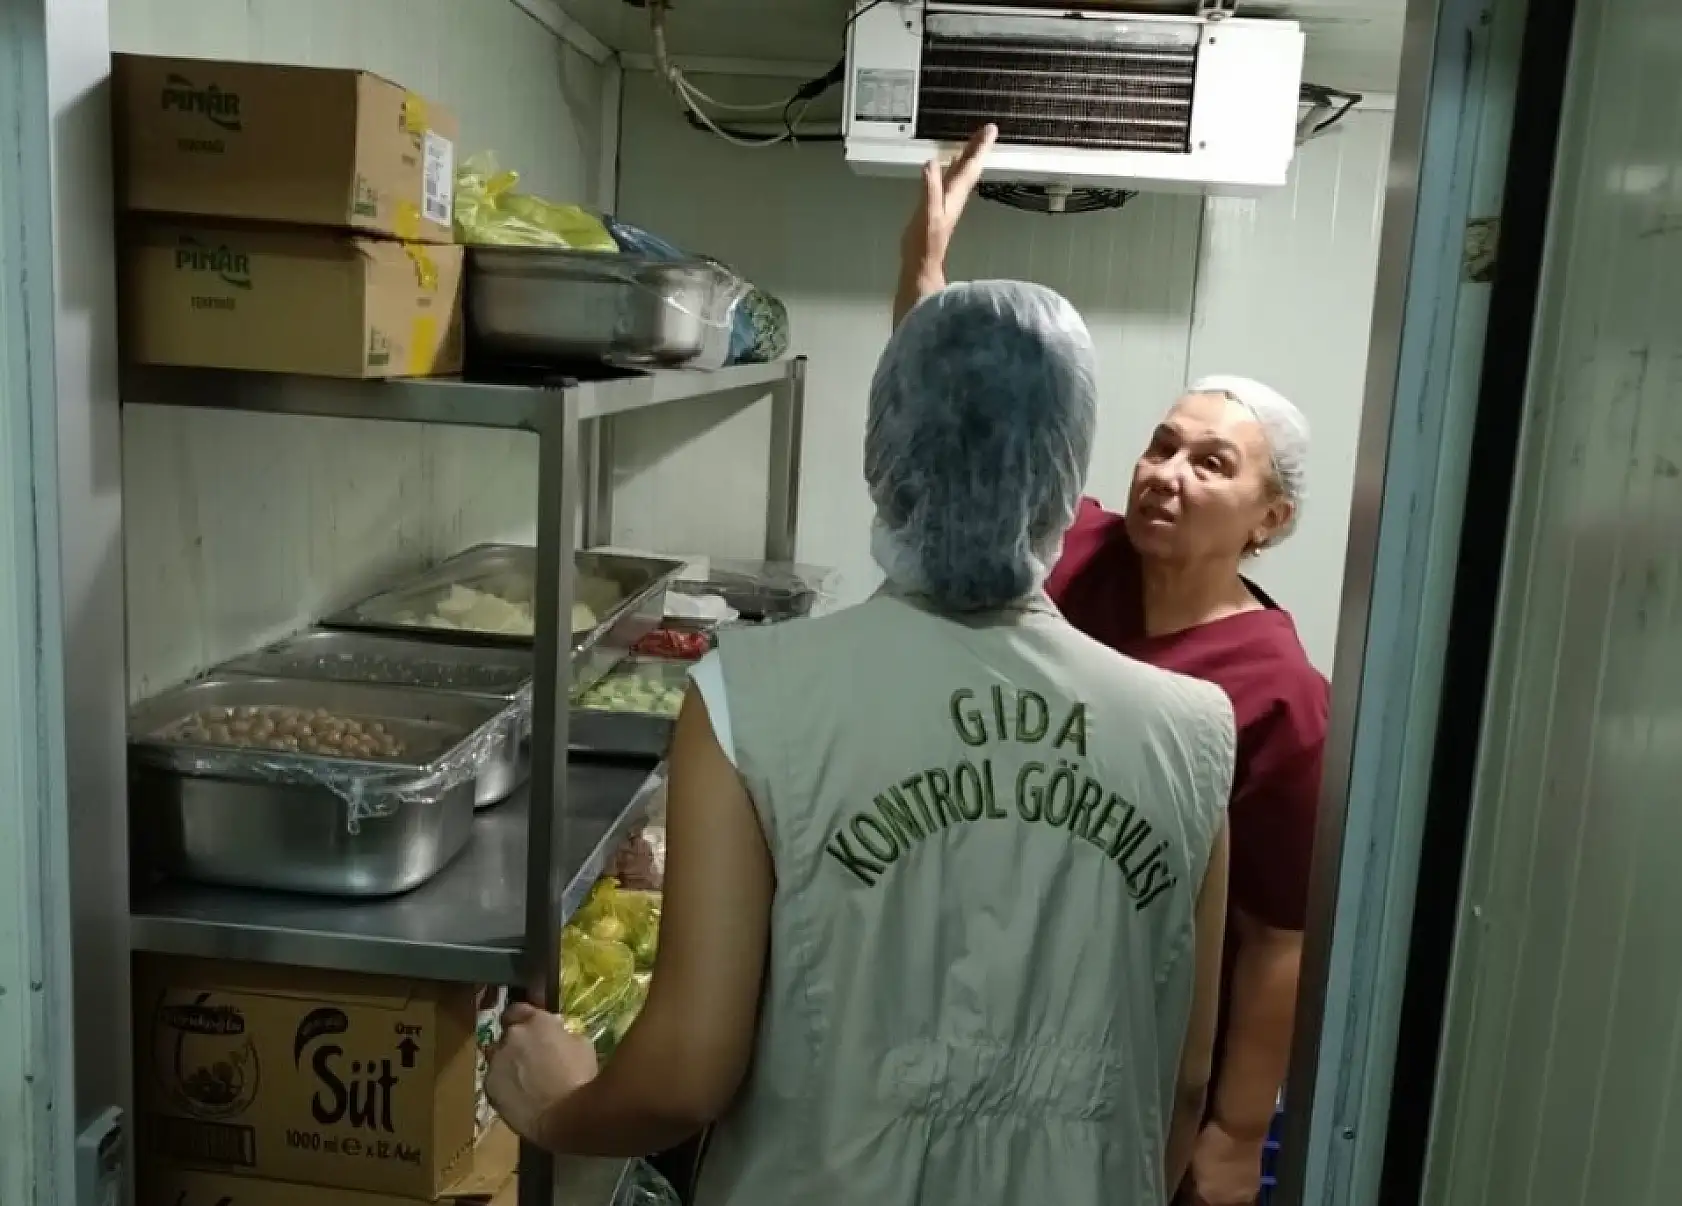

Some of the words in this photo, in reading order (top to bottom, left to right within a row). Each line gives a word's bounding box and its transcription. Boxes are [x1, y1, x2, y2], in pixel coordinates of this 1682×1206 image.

[949, 684, 1088, 757] GIDA
[826, 758, 1007, 887] KONTROL
[1015, 758, 1177, 911] GÖREVLİSİ
[311, 1045, 399, 1133] Süt
[285, 1127, 321, 1151] 1000
